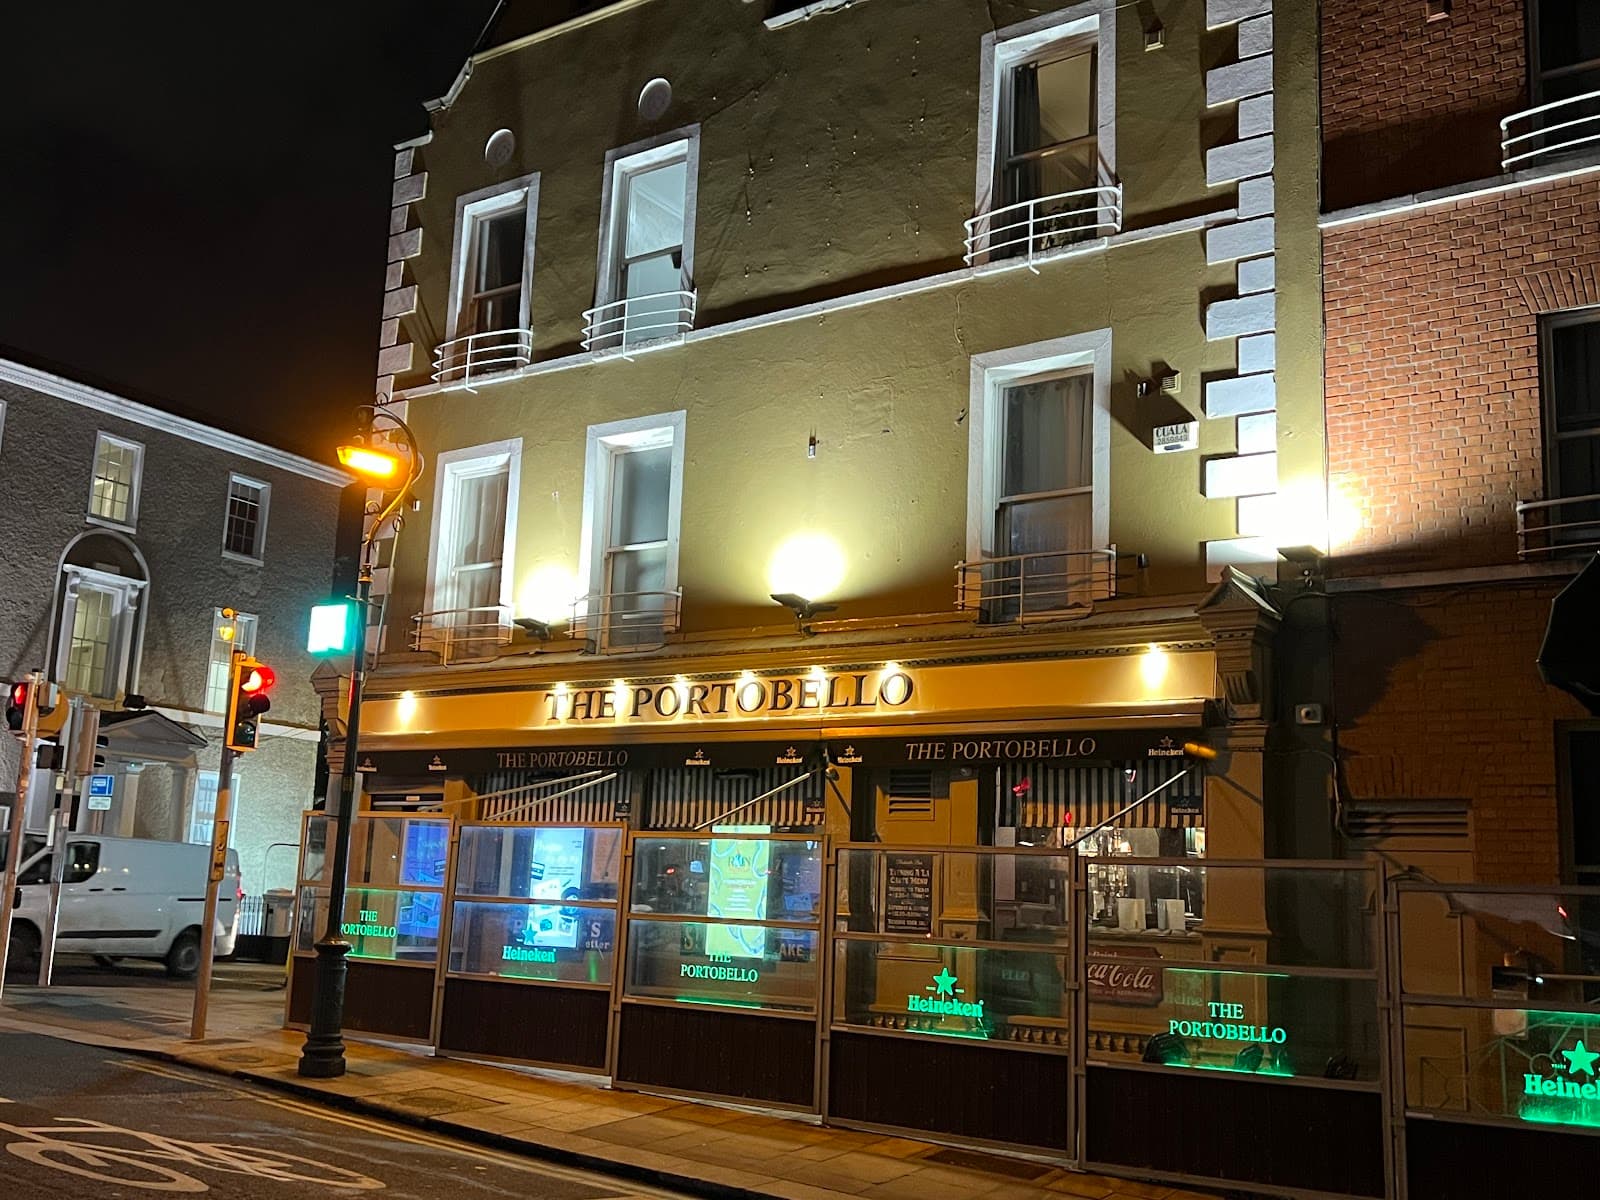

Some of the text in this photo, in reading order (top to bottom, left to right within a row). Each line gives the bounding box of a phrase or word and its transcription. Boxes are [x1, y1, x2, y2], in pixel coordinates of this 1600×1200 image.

[1155, 424, 1188, 438] CUALA
[544, 672, 914, 721] THE PORTOBELLO
[906, 736, 1096, 761] THE PORTOBELLO
[1148, 748, 1184, 757] Heineken
[496, 750, 629, 769] THE PORTOBELLO
[359, 910, 378, 922] THE
[502, 945, 557, 963] Heineken
[680, 963, 758, 983] PORTOBELLO
[908, 994, 984, 1018] Heineken
[1207, 1001, 1245, 1020] THE
[1169, 1019, 1287, 1044] PORTOBELLO
